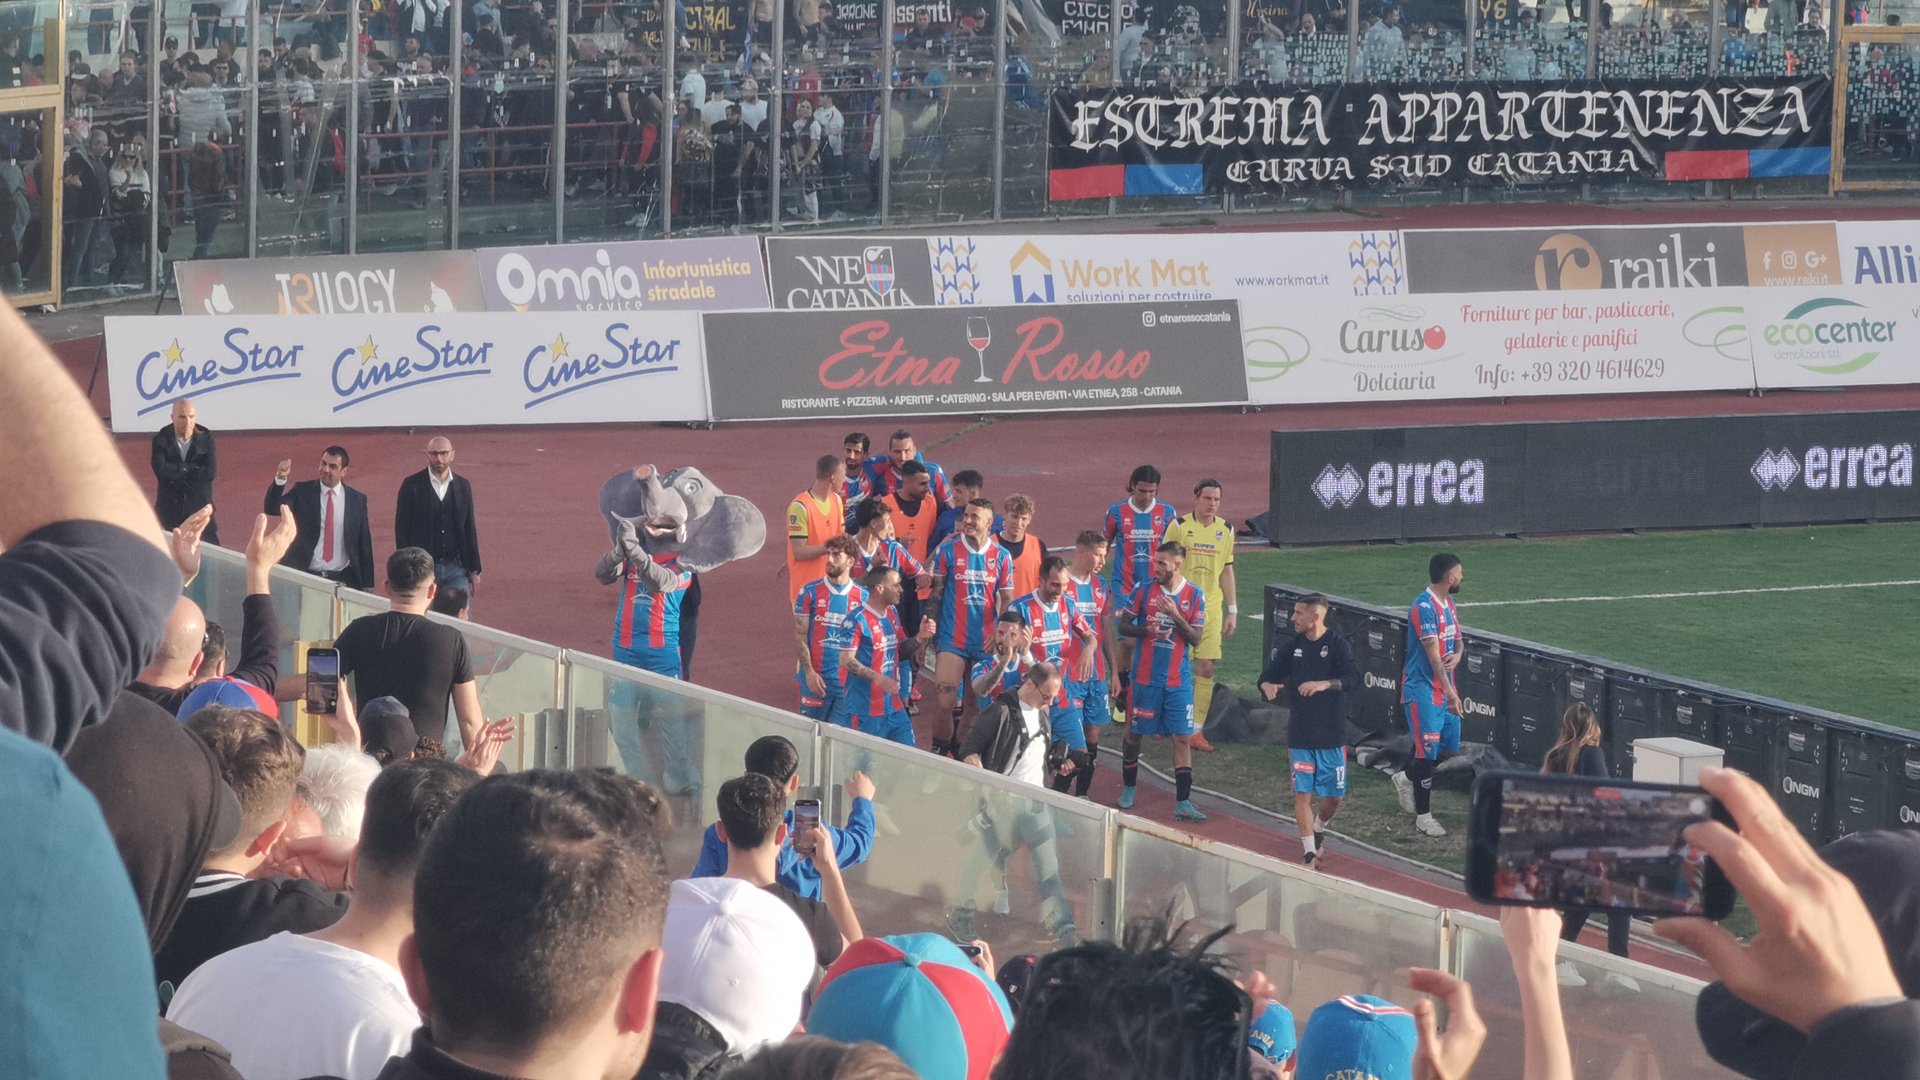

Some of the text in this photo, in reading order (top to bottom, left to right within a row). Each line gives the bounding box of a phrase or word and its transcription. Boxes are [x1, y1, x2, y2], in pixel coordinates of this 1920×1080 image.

[1064, 1, 1133, 19] CICCO
[1070, 84, 1812, 153] ESTREMA APPARTENENZA
[1226, 149, 1640, 183] CURVA SUD CATANIA
[643, 257, 752, 279] Infortunistica
[794, 255, 866, 286] WE
[1060, 257, 1211, 289] Work Mat
[1609, 233, 1719, 289] raiki
[1854, 244, 1920, 285] Alli
[496, 249, 642, 305] Omnia
[648, 280, 716, 302] stradale
[1234, 274, 1330, 287] www.workmat.it
[787, 288, 917, 310] CATANIA
[1460, 303, 1531, 323] Forniture
[1534, 307, 1558, 326] per
[1595, 300, 1675, 324] pasticcerie,
[1158, 310, 1232, 324] etnarossocatania
[1764, 316, 1897, 347] ecocenter
[818, 316, 1152, 390] Etna Rosso
[1503, 327, 1638, 356] gelaterie e panifici
[1774, 348, 1825, 361] demolizioni
[136, 327, 304, 401] CineStar
[331, 325, 494, 397] CineStar
[523, 322, 681, 394] CineStar
[1475, 357, 1665, 390] Info: +39 320 4614629
[1353, 371, 1436, 393] Dolciaria
[781, 396, 841, 409] RISTORANTE
[846, 395, 888, 407] PIZZERIA
[894, 394, 935, 406] APERITIF
[940, 392, 987, 404] CATERING
[991, 391, 1016, 403] SALA
[1016, 391, 1034, 401] PER
[1034, 389, 1068, 401] EVENTI
[1072, 388, 1088, 400] VIA
[1120, 387, 1138, 398] 258
[1803, 442, 1914, 491] errea
[1367, 457, 1486, 508] errea
